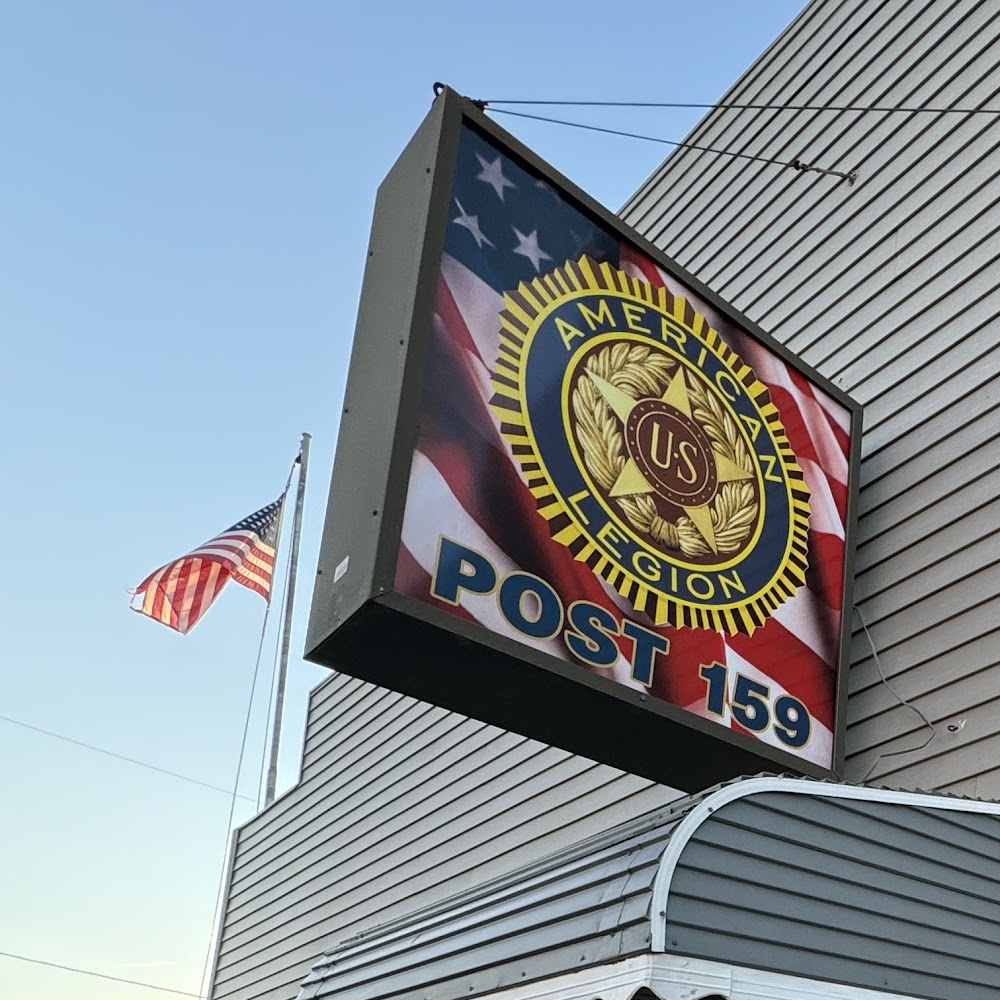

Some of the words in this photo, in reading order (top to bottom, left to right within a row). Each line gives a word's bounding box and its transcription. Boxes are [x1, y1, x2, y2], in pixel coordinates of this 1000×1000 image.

[554, 299, 783, 485] AMERICAN
[566, 488, 745, 601] LEGION
[430, 533, 670, 688] POST
[699, 660, 812, 750] 159
